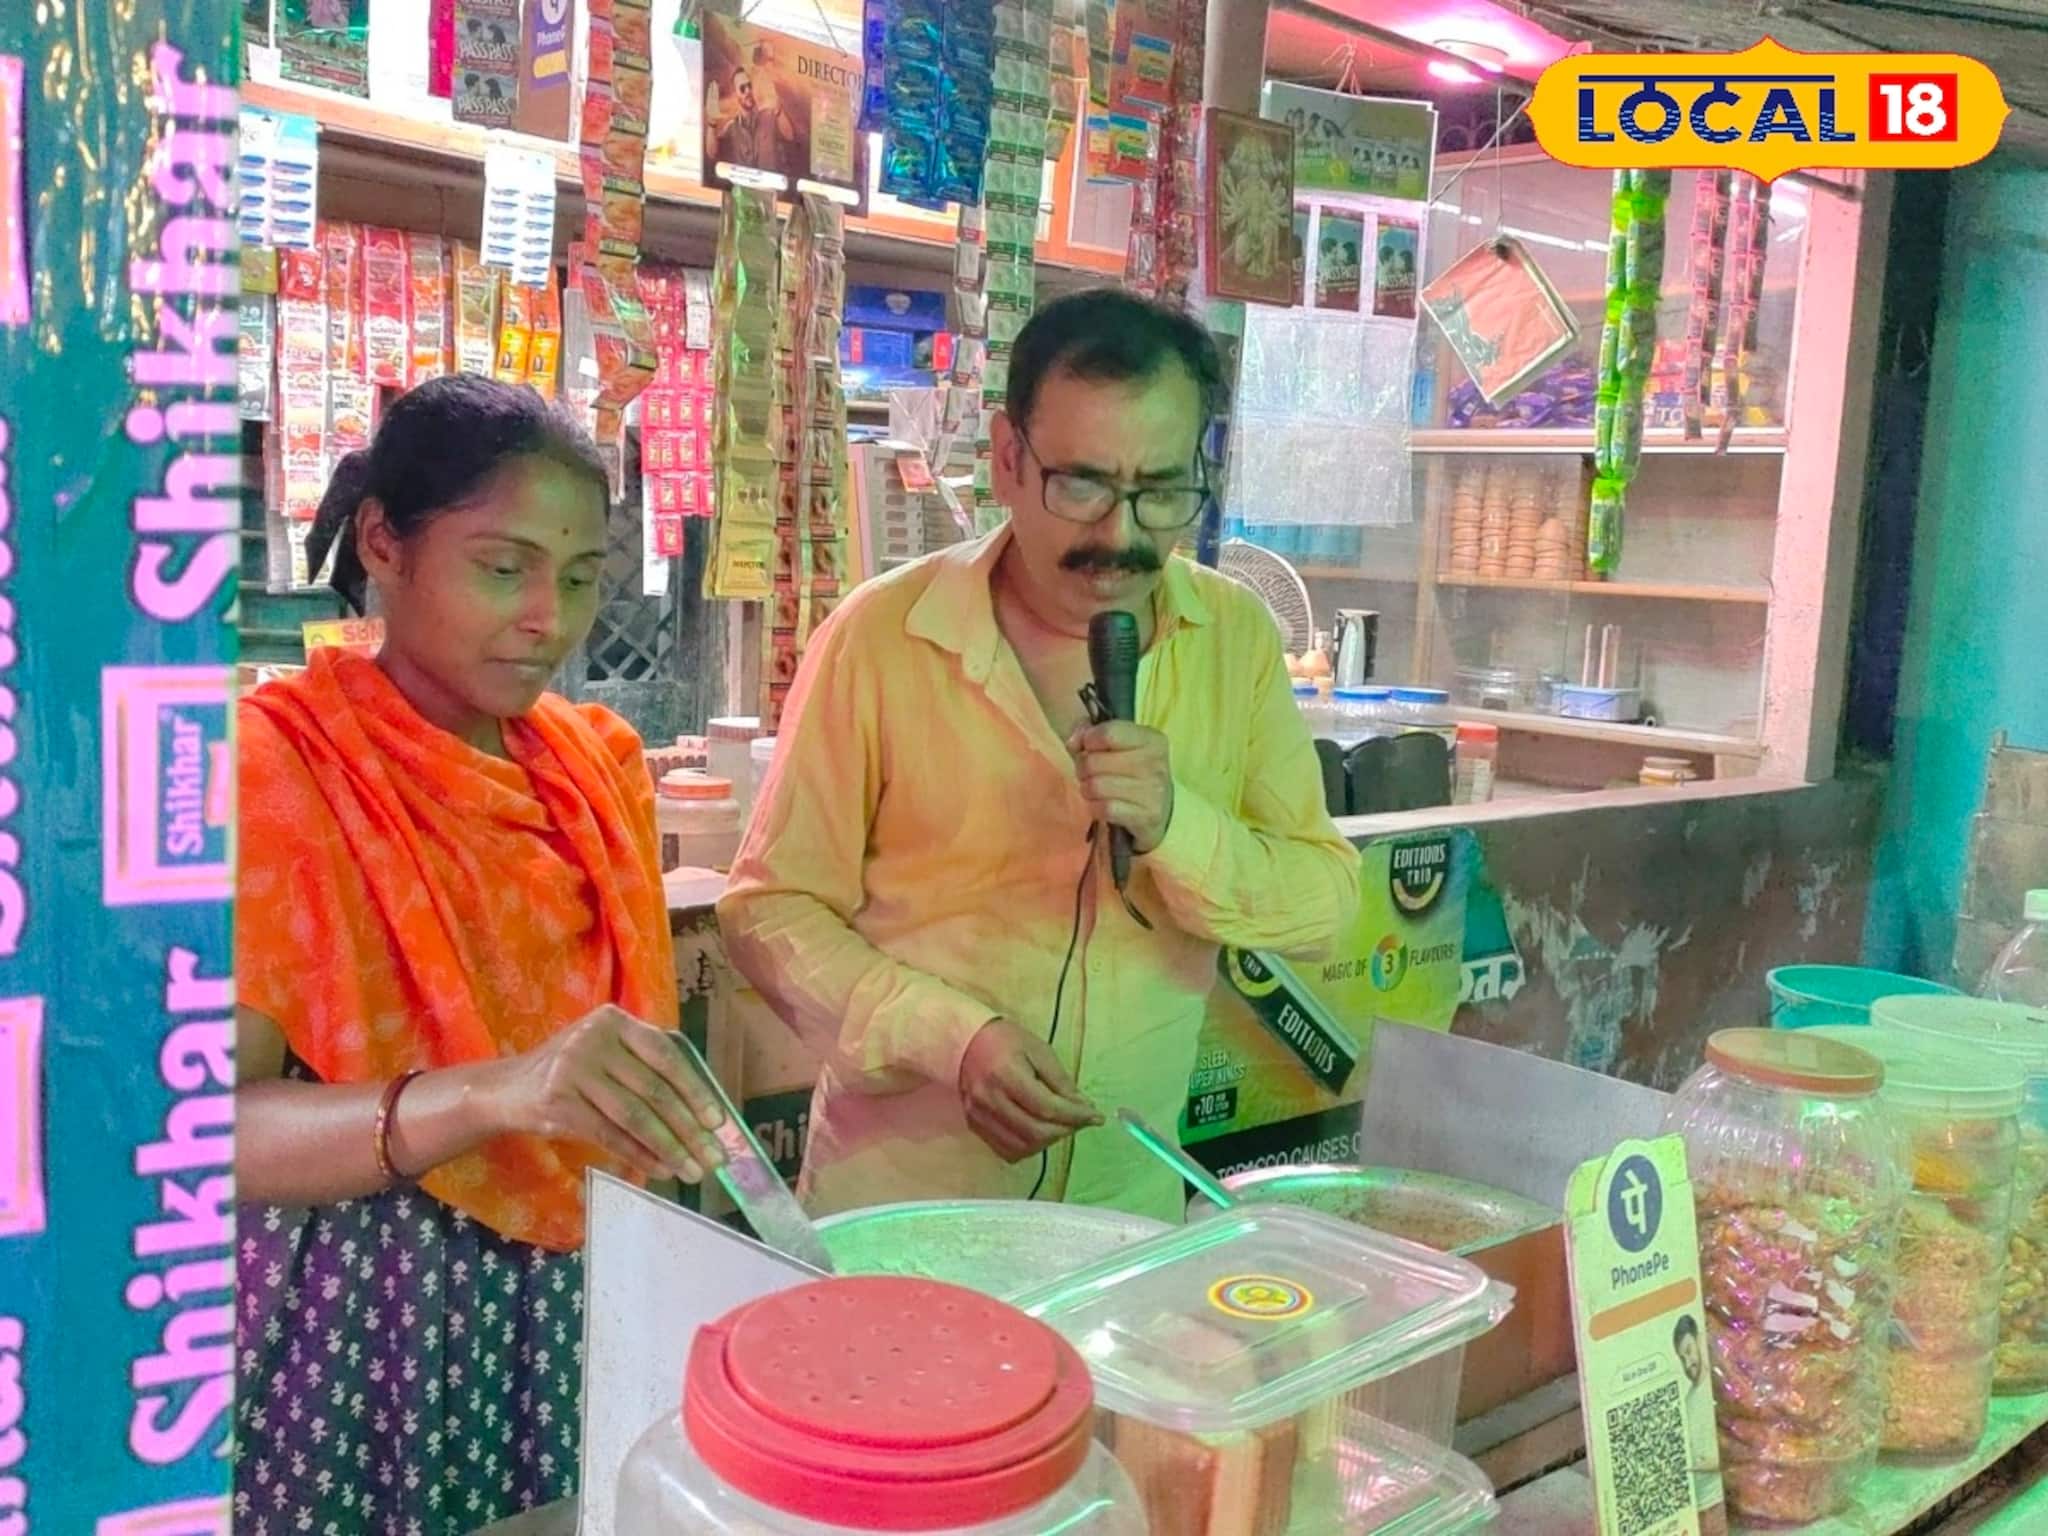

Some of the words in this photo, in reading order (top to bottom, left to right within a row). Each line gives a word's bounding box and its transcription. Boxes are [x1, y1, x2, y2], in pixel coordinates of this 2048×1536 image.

[125, 42, 240, 622] Shikhar
[164, 715, 205, 856] Shikhar
[1393, 844, 1446, 869] EDITIONS
[1406, 867, 1432, 887] TRIO
[1321, 960, 1353, 984] MAGIC
[1355, 957, 1368, 977] OF
[1384, 954, 1394, 975] 3
[1277, 1002, 1338, 1074] EDITIONS
[1292, 1134, 1349, 1164] CAUSES
[125, 946, 236, 1466] Shikhar
[1611, 1251, 1670, 1290] PhonePe
